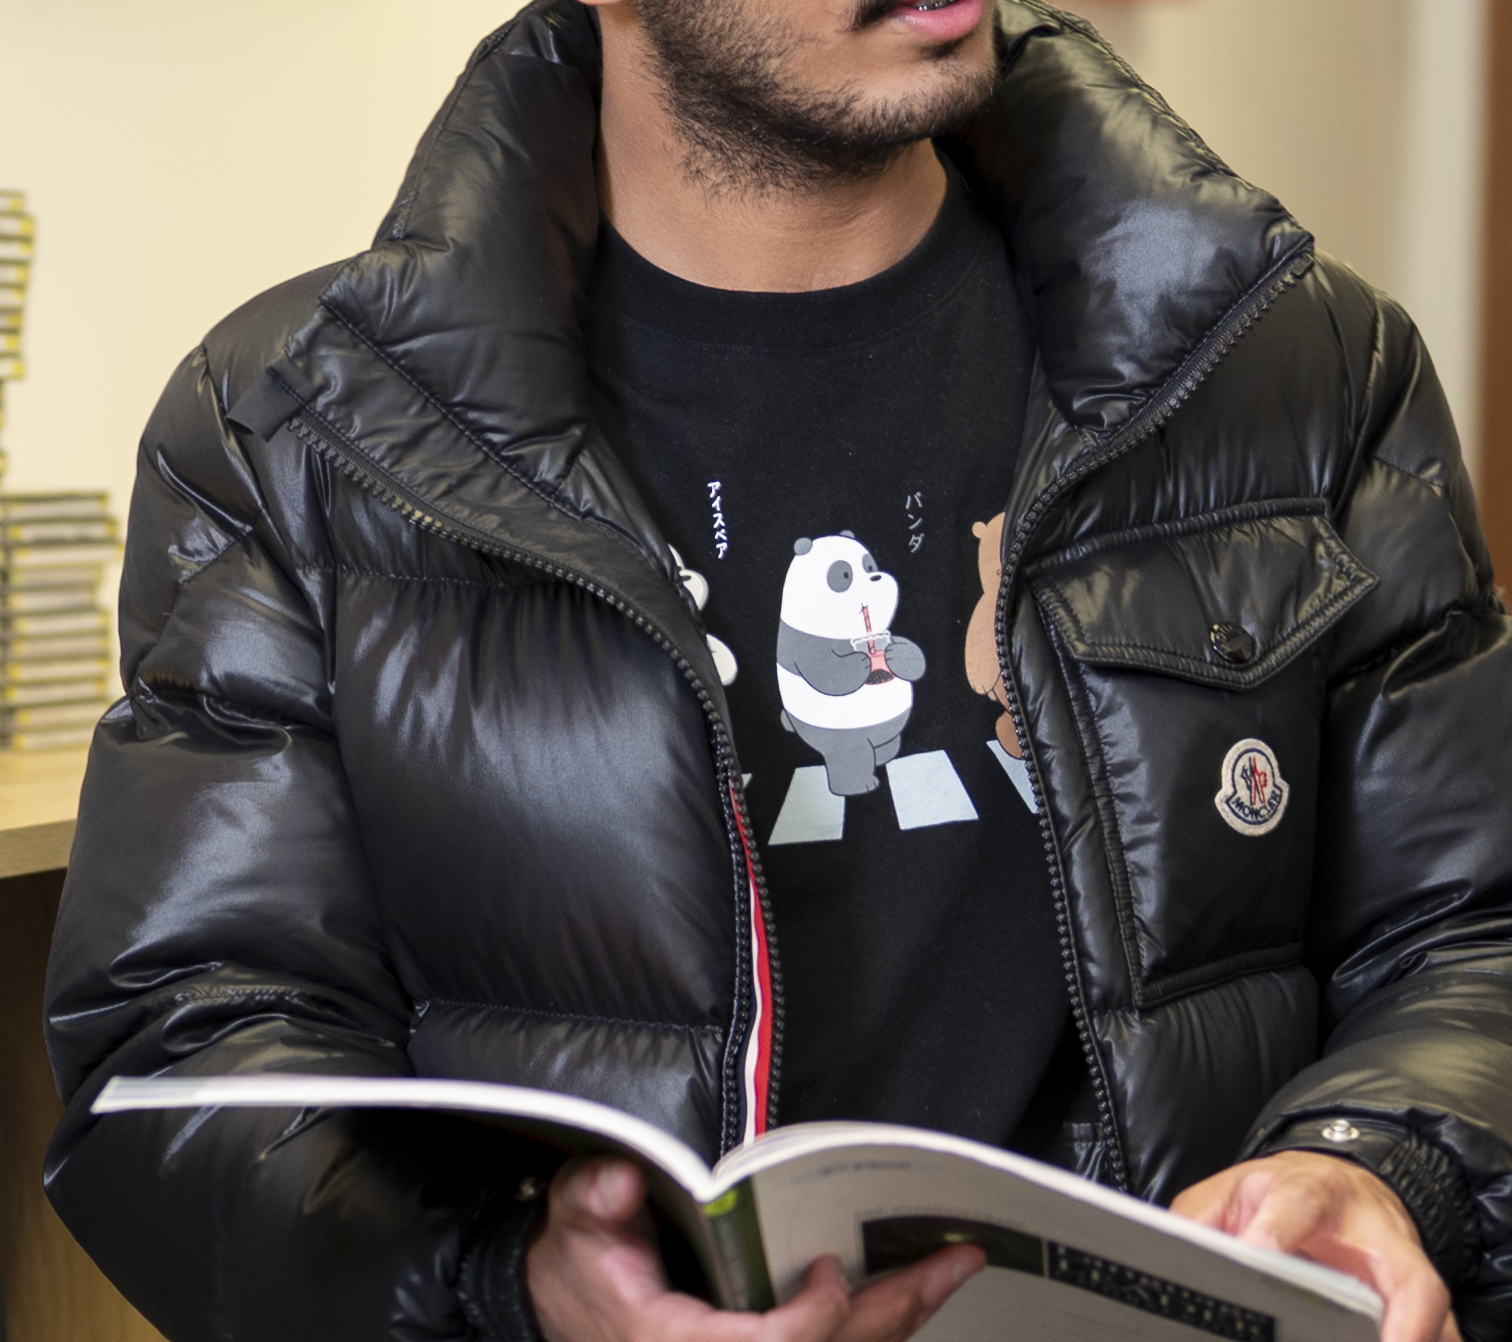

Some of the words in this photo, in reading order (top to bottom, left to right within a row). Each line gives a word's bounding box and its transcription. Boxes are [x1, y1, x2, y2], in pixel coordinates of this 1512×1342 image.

[905, 491, 925, 553] パンダ
[1232, 790, 1282, 821] MONCLER
